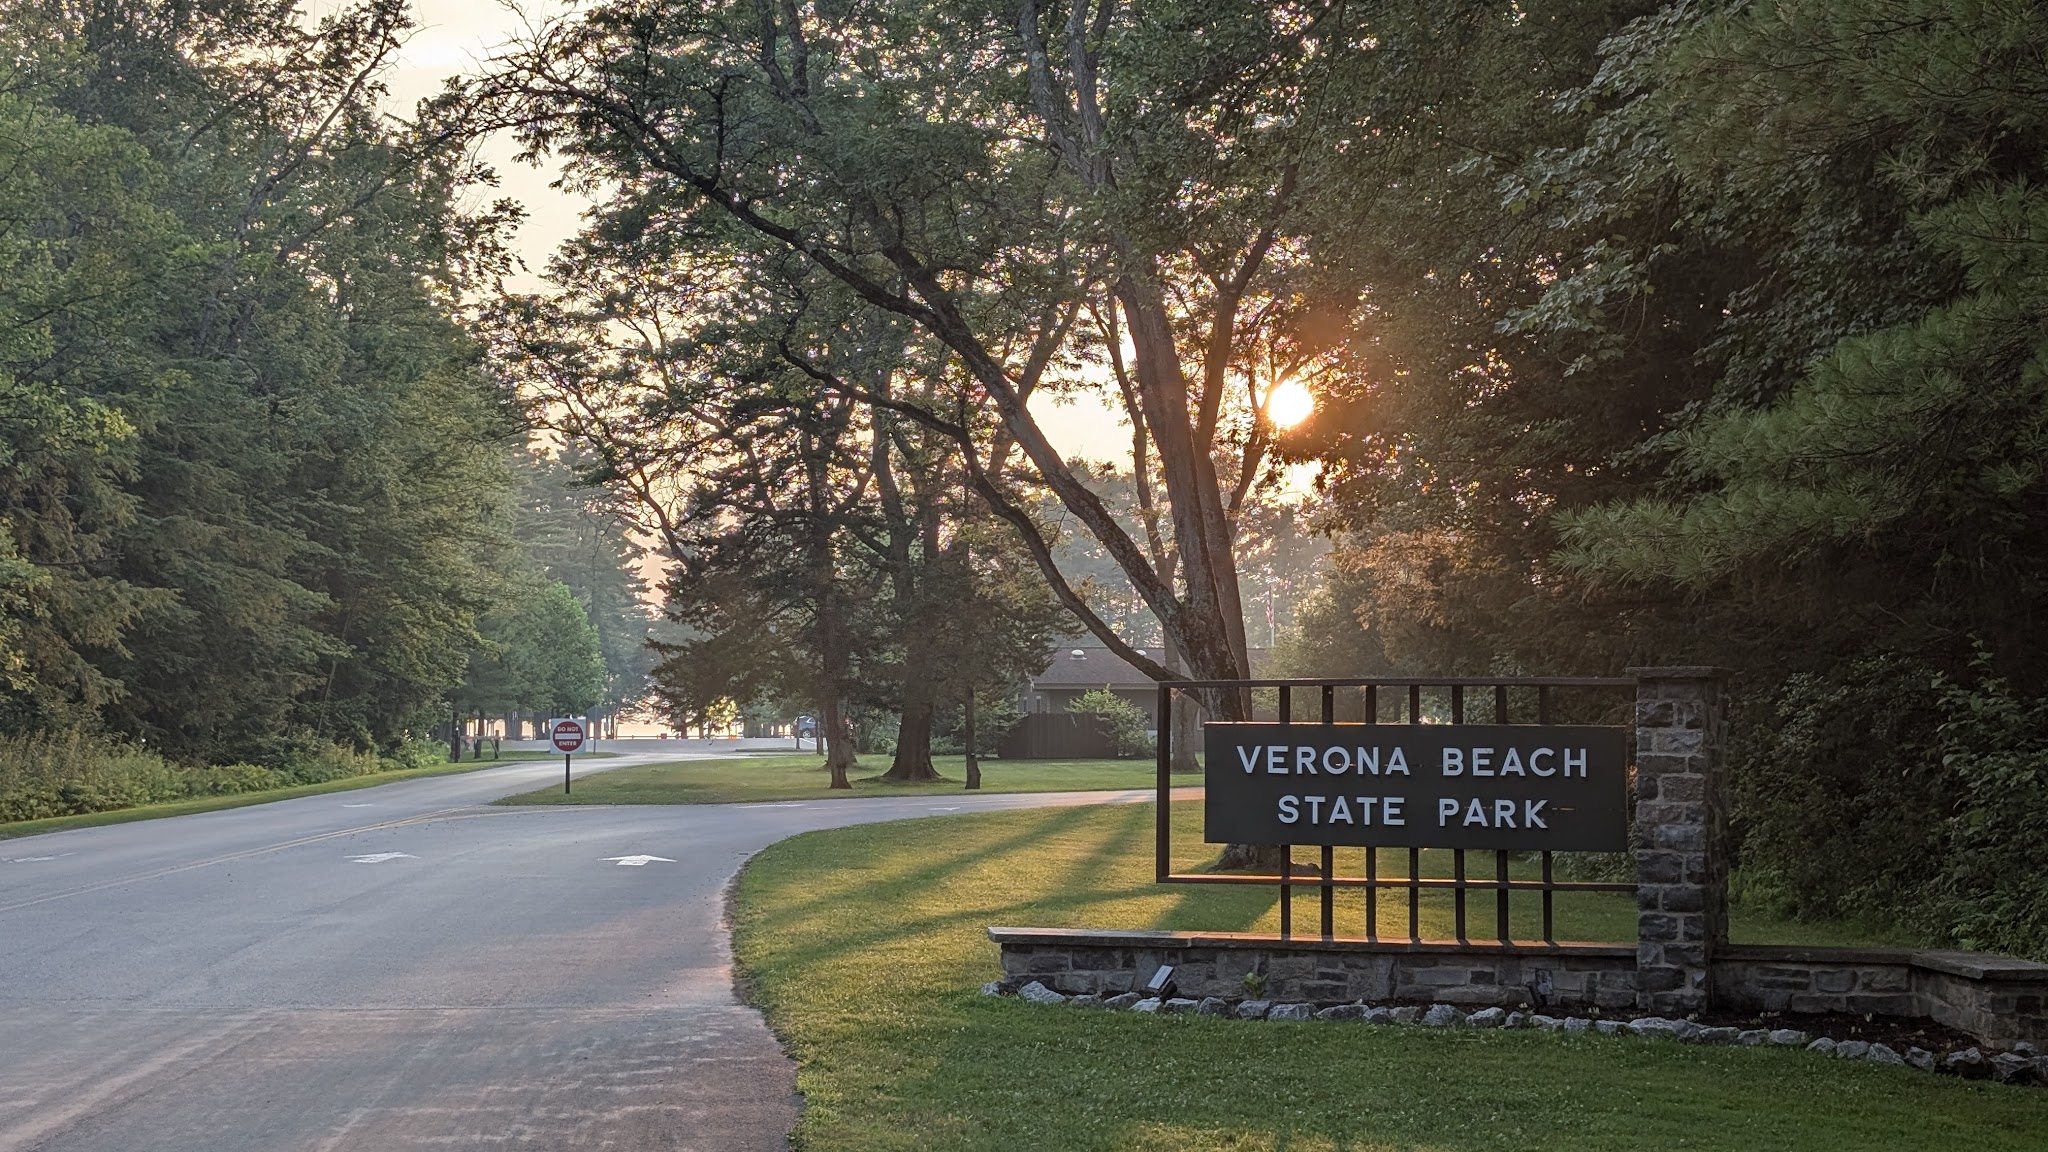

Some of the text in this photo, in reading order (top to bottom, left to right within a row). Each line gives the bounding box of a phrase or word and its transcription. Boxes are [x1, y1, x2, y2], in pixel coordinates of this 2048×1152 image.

[1236, 745, 1588, 778] VERONA BEACH
[1277, 794, 1549, 829] STATE PARK
